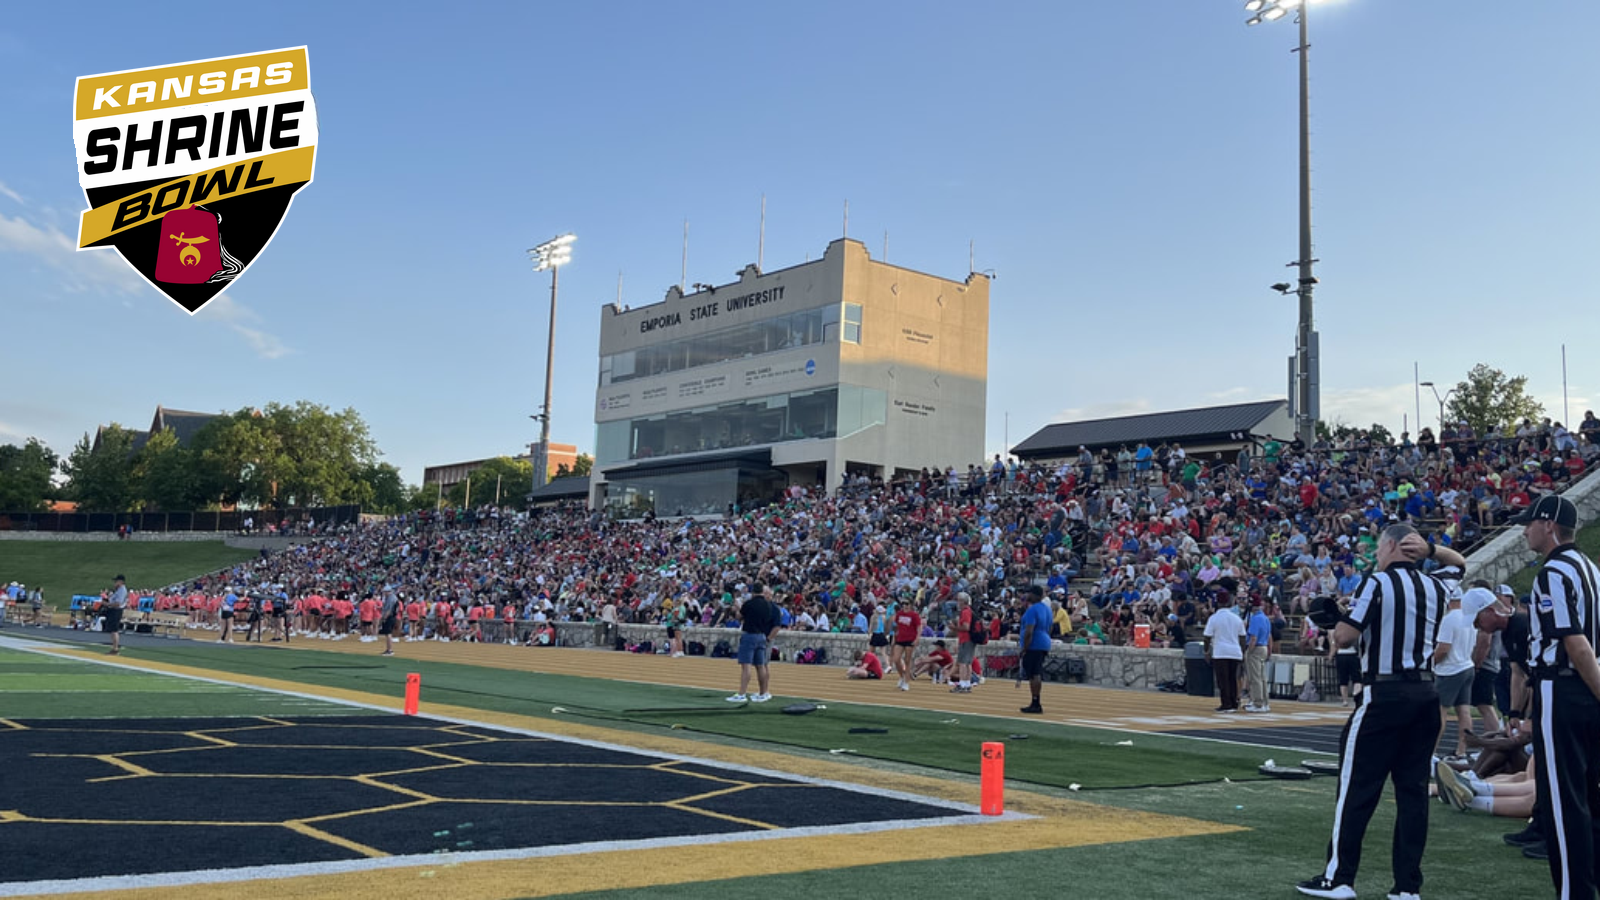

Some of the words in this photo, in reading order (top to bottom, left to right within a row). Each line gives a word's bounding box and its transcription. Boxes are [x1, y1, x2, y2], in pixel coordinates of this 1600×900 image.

[640, 312, 682, 333] EMPORIA
[689, 303, 719, 321] STATE
[726, 286, 786, 312] UNIVERSITY
